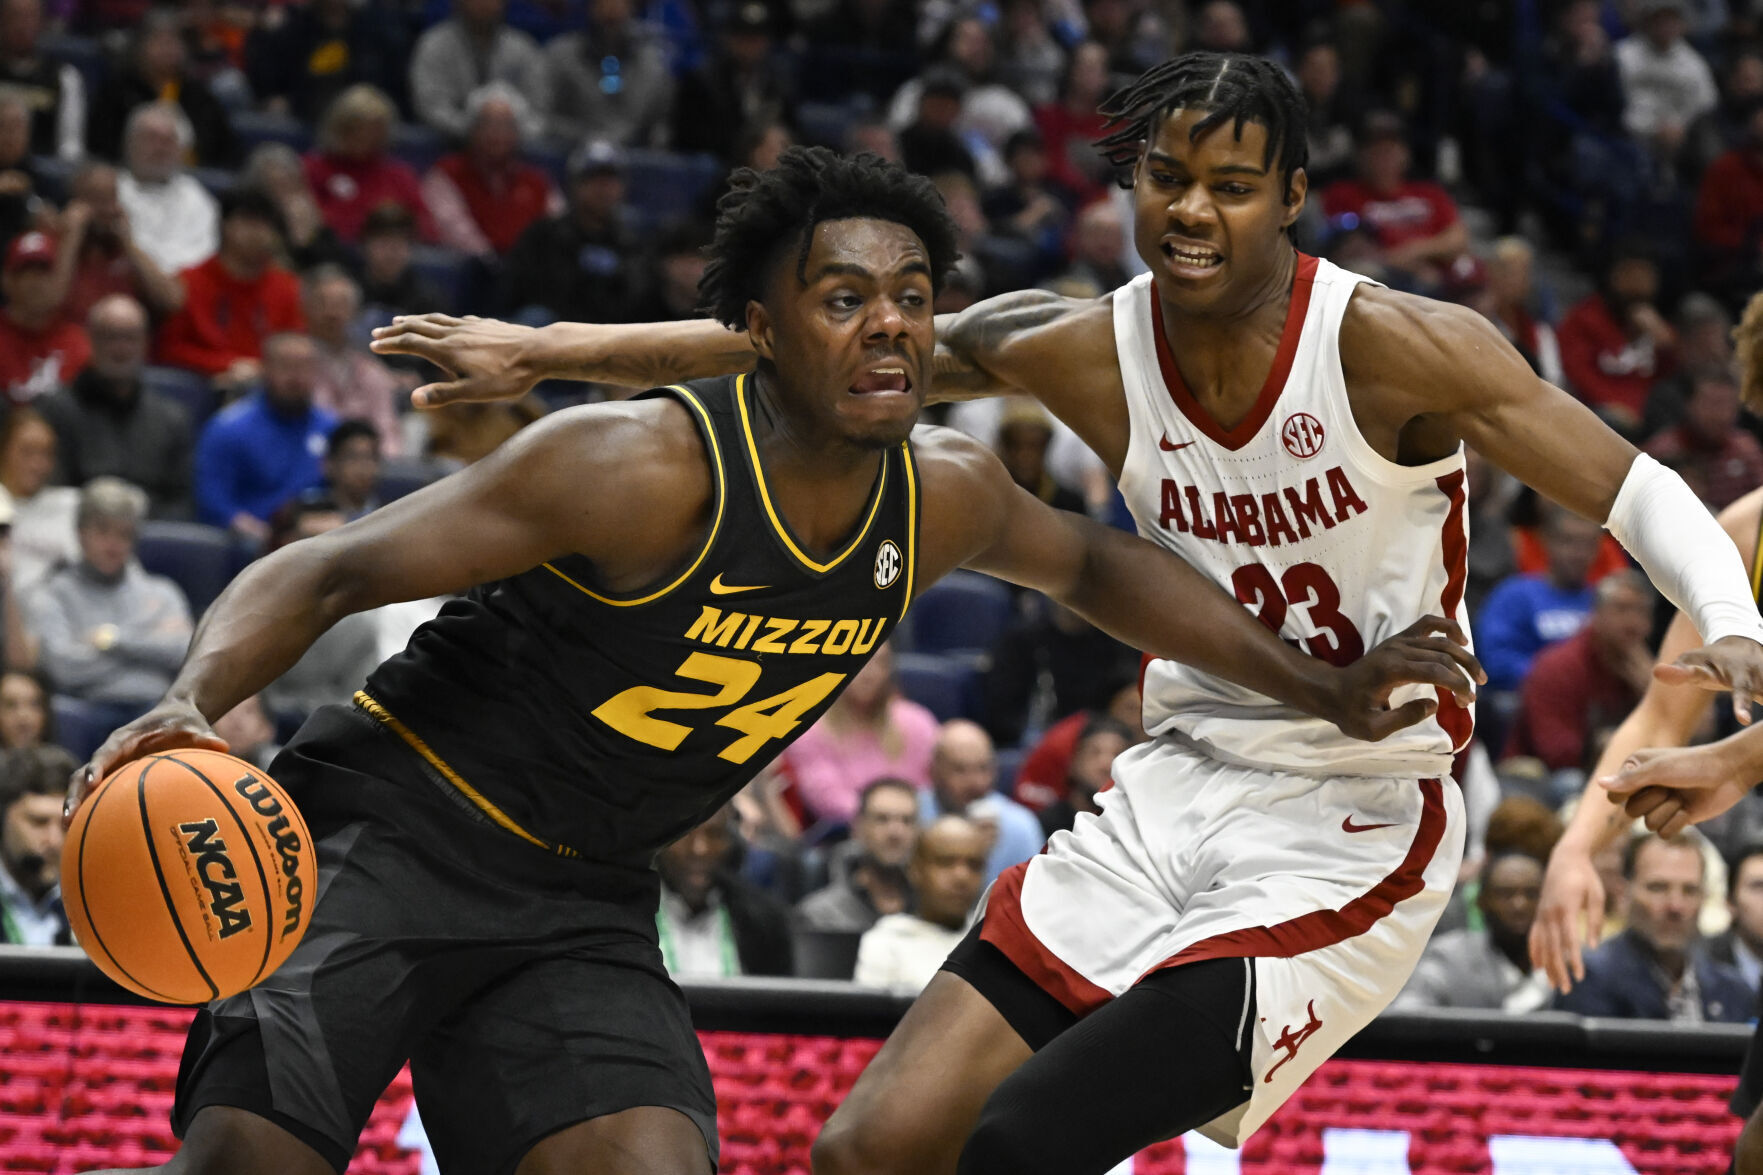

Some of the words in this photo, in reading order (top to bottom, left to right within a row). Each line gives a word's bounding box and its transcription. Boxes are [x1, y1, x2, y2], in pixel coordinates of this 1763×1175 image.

[1284, 414, 1323, 457] SEC
[1159, 466, 1369, 547] ALABAMA
[875, 543, 899, 586] SEC
[684, 605, 887, 655] MIZZOU
[1231, 562, 1365, 668] 23
[590, 651, 848, 765] 24
[178, 818, 253, 941] NCAA
[234, 772, 303, 944] Wilson
